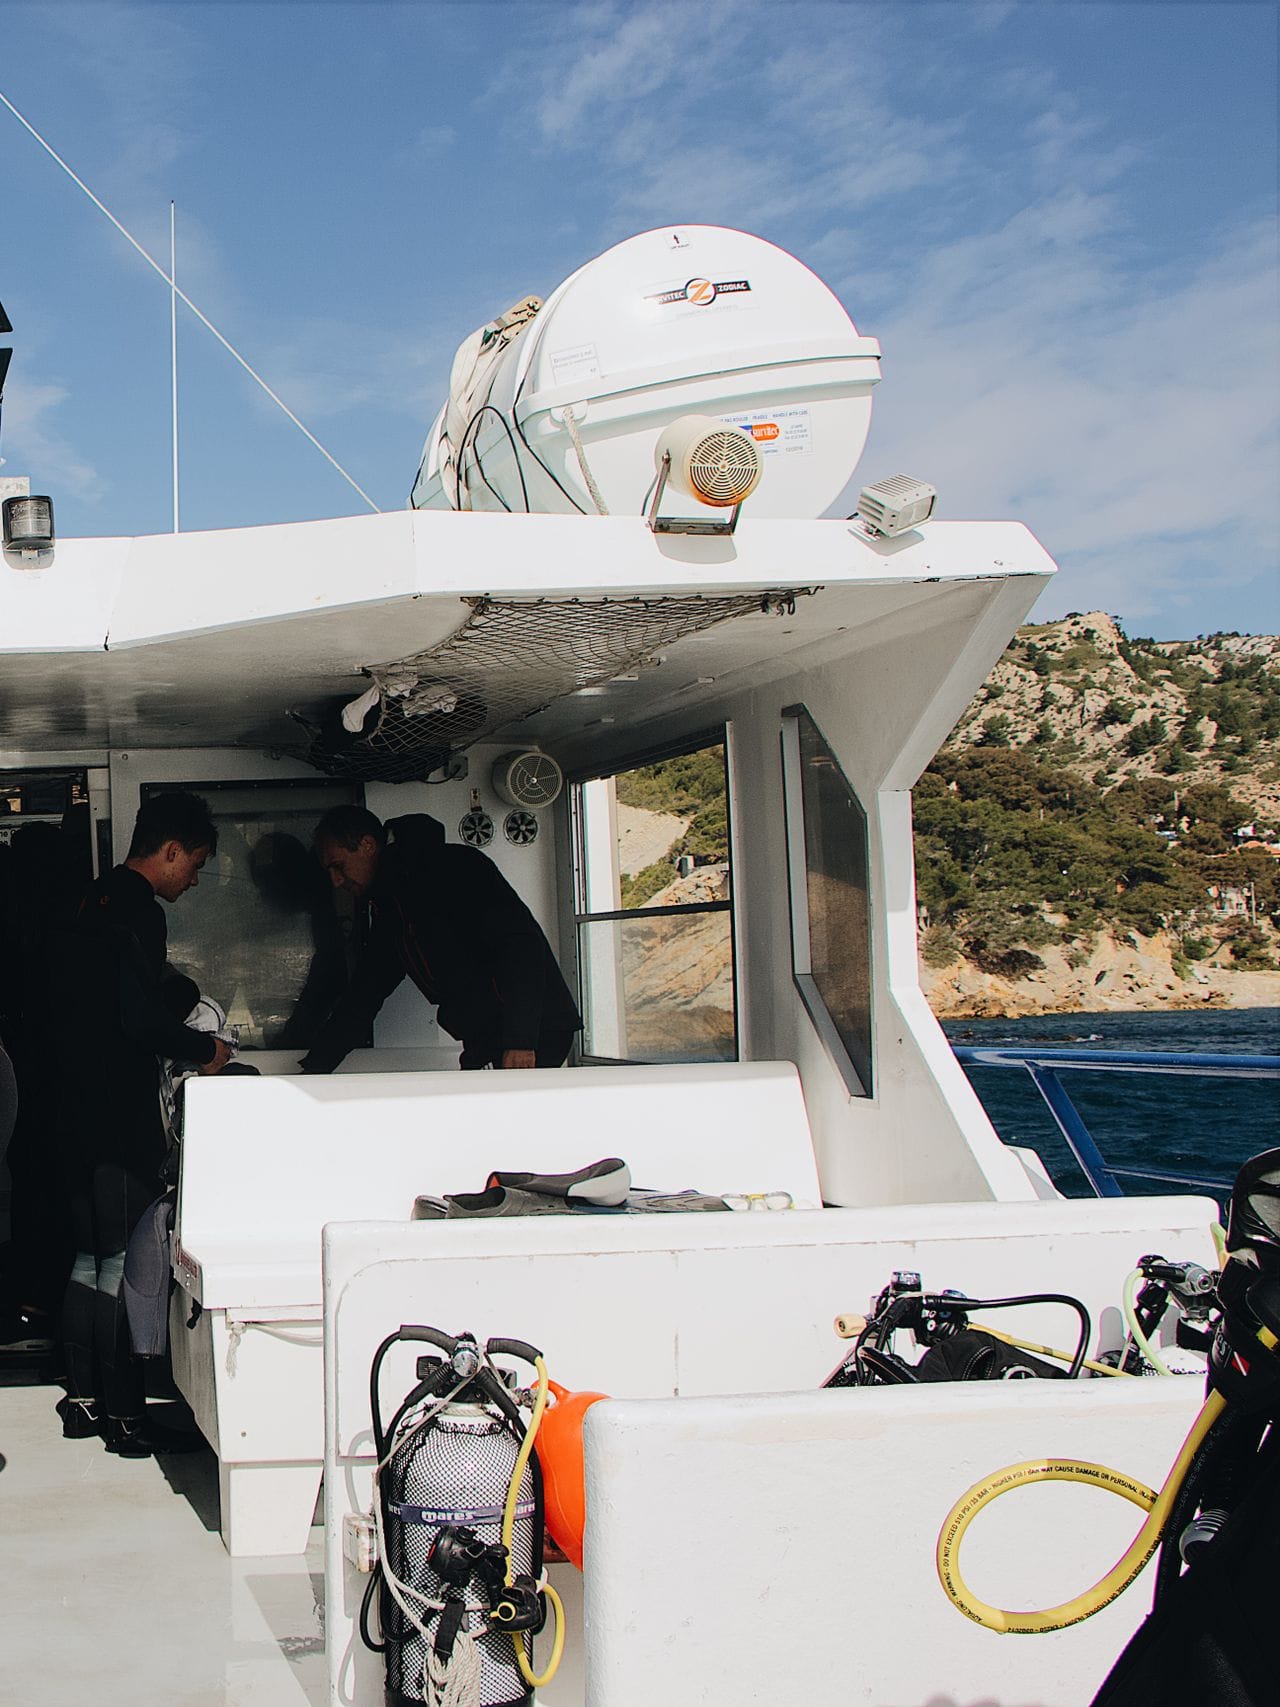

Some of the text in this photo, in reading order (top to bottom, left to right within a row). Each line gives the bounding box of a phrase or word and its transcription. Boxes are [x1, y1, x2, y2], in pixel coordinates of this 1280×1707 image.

[718, 282, 747, 293] ZODIAC
[1054, 1465, 1075, 1473] CAUSE
[1075, 1467, 1100, 1478] DAMAGE
[1101, 1472, 1110, 1481] OR
[1110, 1476, 1138, 1494] PERSONAL
[977, 1487, 989, 1500] BAR
[421, 1510, 474, 1523] mares
[945, 1524, 958, 1545] EXCEED
[943, 1545, 951, 1558] NOT
[944, 1572, 957, 1597] WARNING
